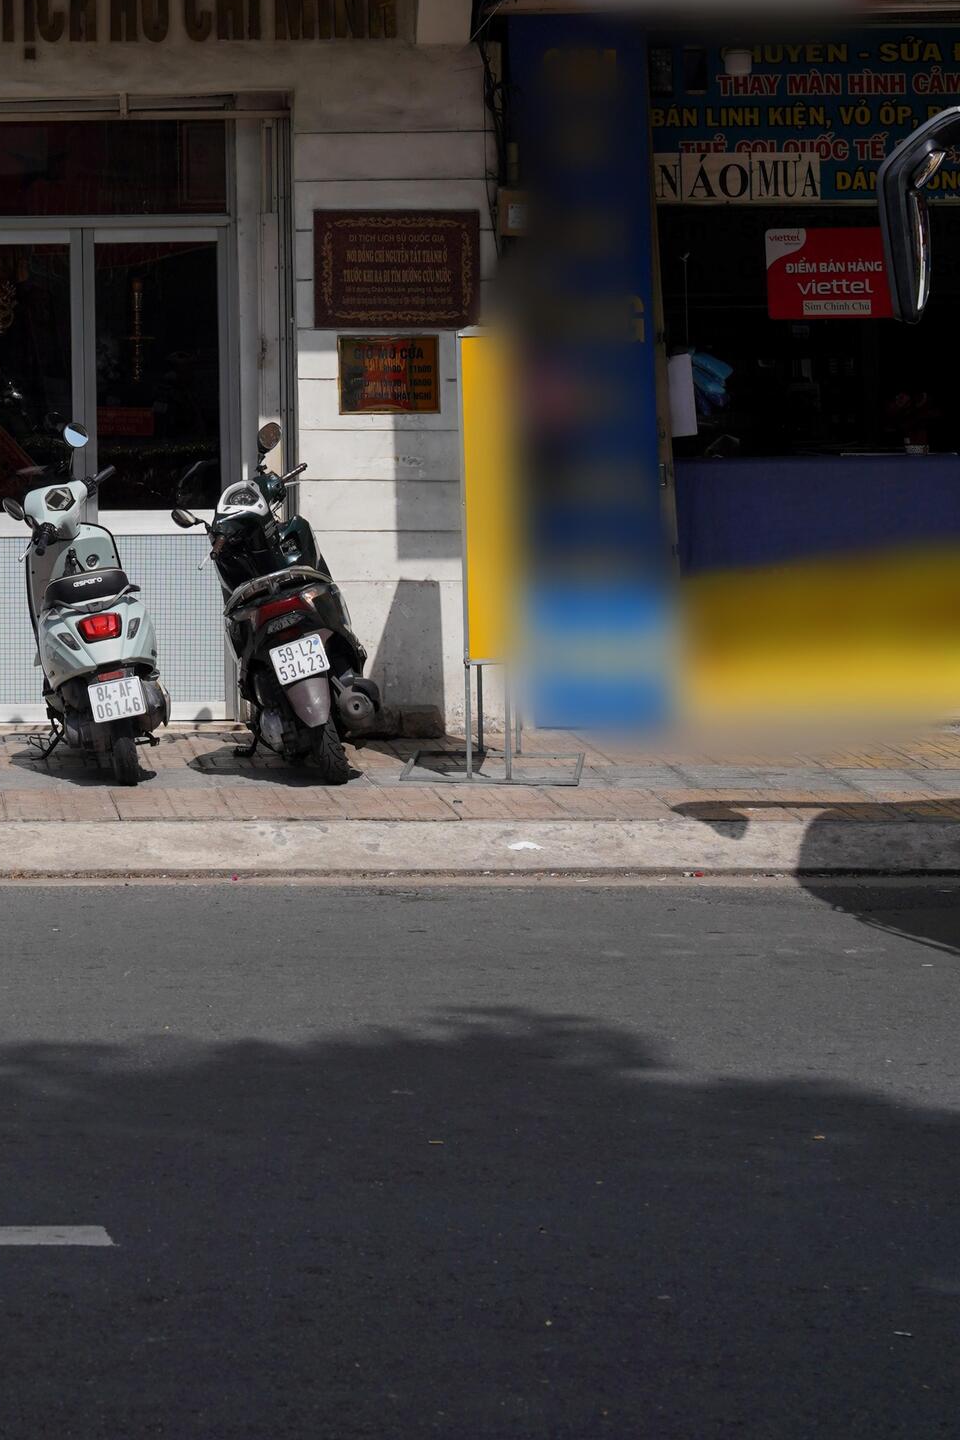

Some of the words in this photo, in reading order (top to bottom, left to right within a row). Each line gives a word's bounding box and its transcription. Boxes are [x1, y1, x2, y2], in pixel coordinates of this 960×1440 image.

[720, 38, 849, 64] HUYÊN
[879, 35, 944, 64] SỬA
[716, 73, 781, 97] THAY
[786, 68, 843, 97] MÀN
[847, 69, 906, 97] HÌNH
[650, 103, 700, 128] BÁN
[705, 106, 760, 128] LINH
[767, 101, 832, 130] KIỆN,
[838, 96, 873, 127] VỎ
[853, 130, 890, 161] TẾ
[688, 154, 749, 199] ÁO
[758, 155, 819, 199] MƯA
[768, 233, 801, 242] viettel
[785, 257, 817, 274] ĐIỂM
[819, 258, 846, 273] BÁN
[847, 258, 883, 273] HÀNG
[796, 278, 874, 296] viettel
[279, 654, 325, 681] 534.23
[96, 680, 132, 702] 84-AF
[96, 697, 141, 719] 061.46
